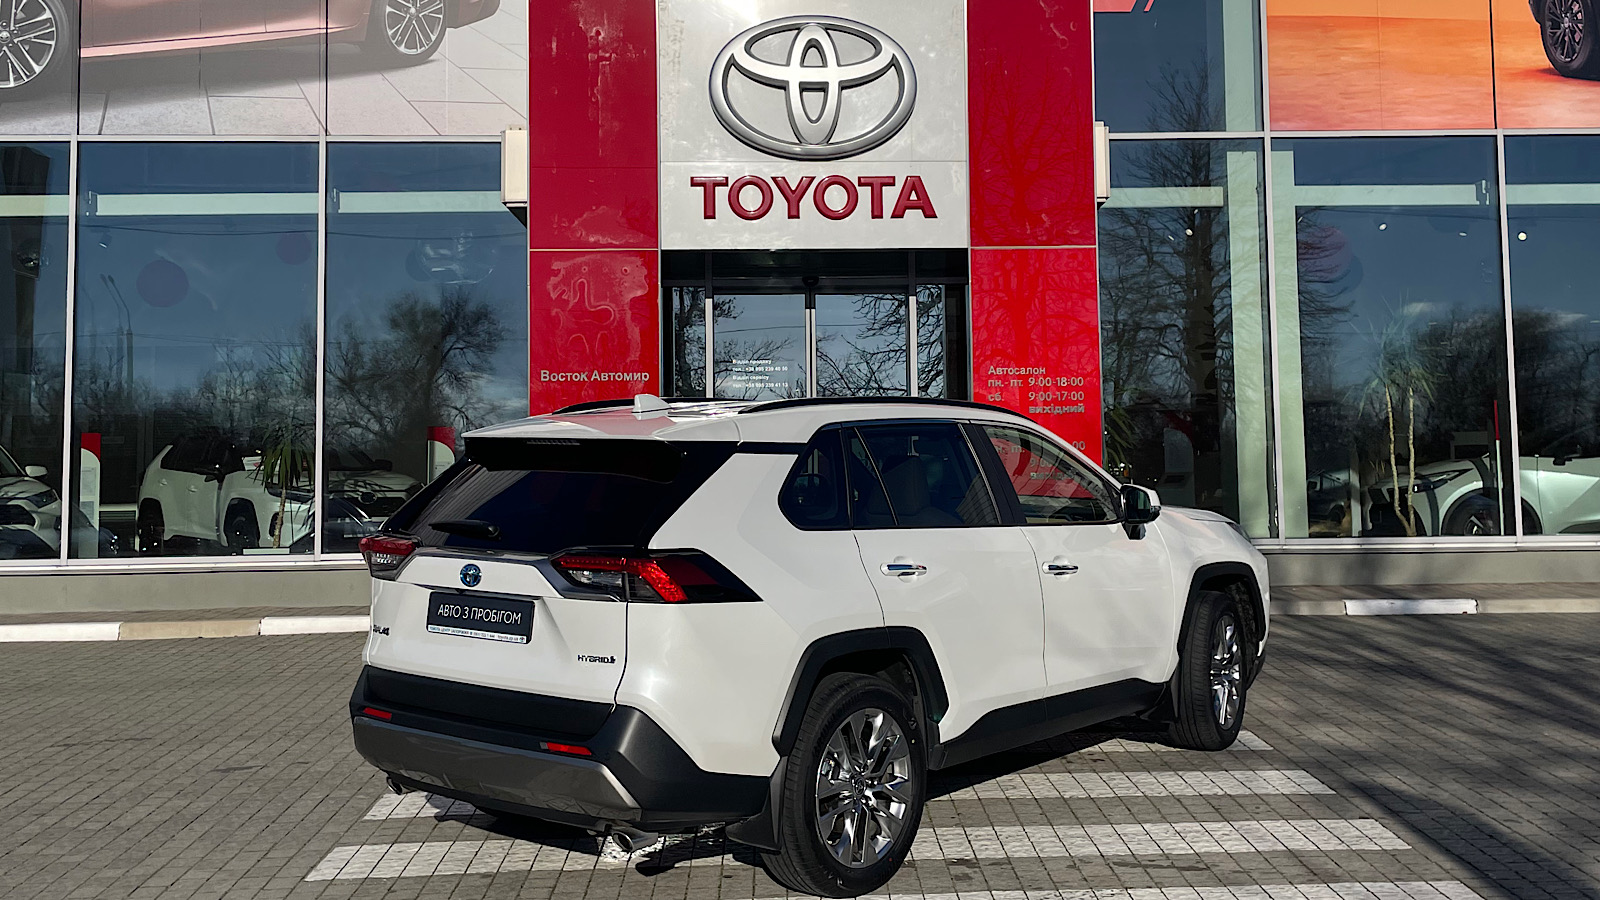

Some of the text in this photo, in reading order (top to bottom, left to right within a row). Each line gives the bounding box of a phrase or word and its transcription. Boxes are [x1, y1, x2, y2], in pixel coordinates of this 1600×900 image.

[690, 175, 938, 220] TOYOTA
[540, 369, 650, 384] Восток Автомир
[988, 366, 1046, 375] Автосалон
[988, 391, 1085, 401] сб. 9:00-17:00
[1029, 403, 1085, 415] вихідний
[437, 604, 522, 625] АВТО З ПРОБІГОМ
[577, 654, 609, 663] HYBRID
